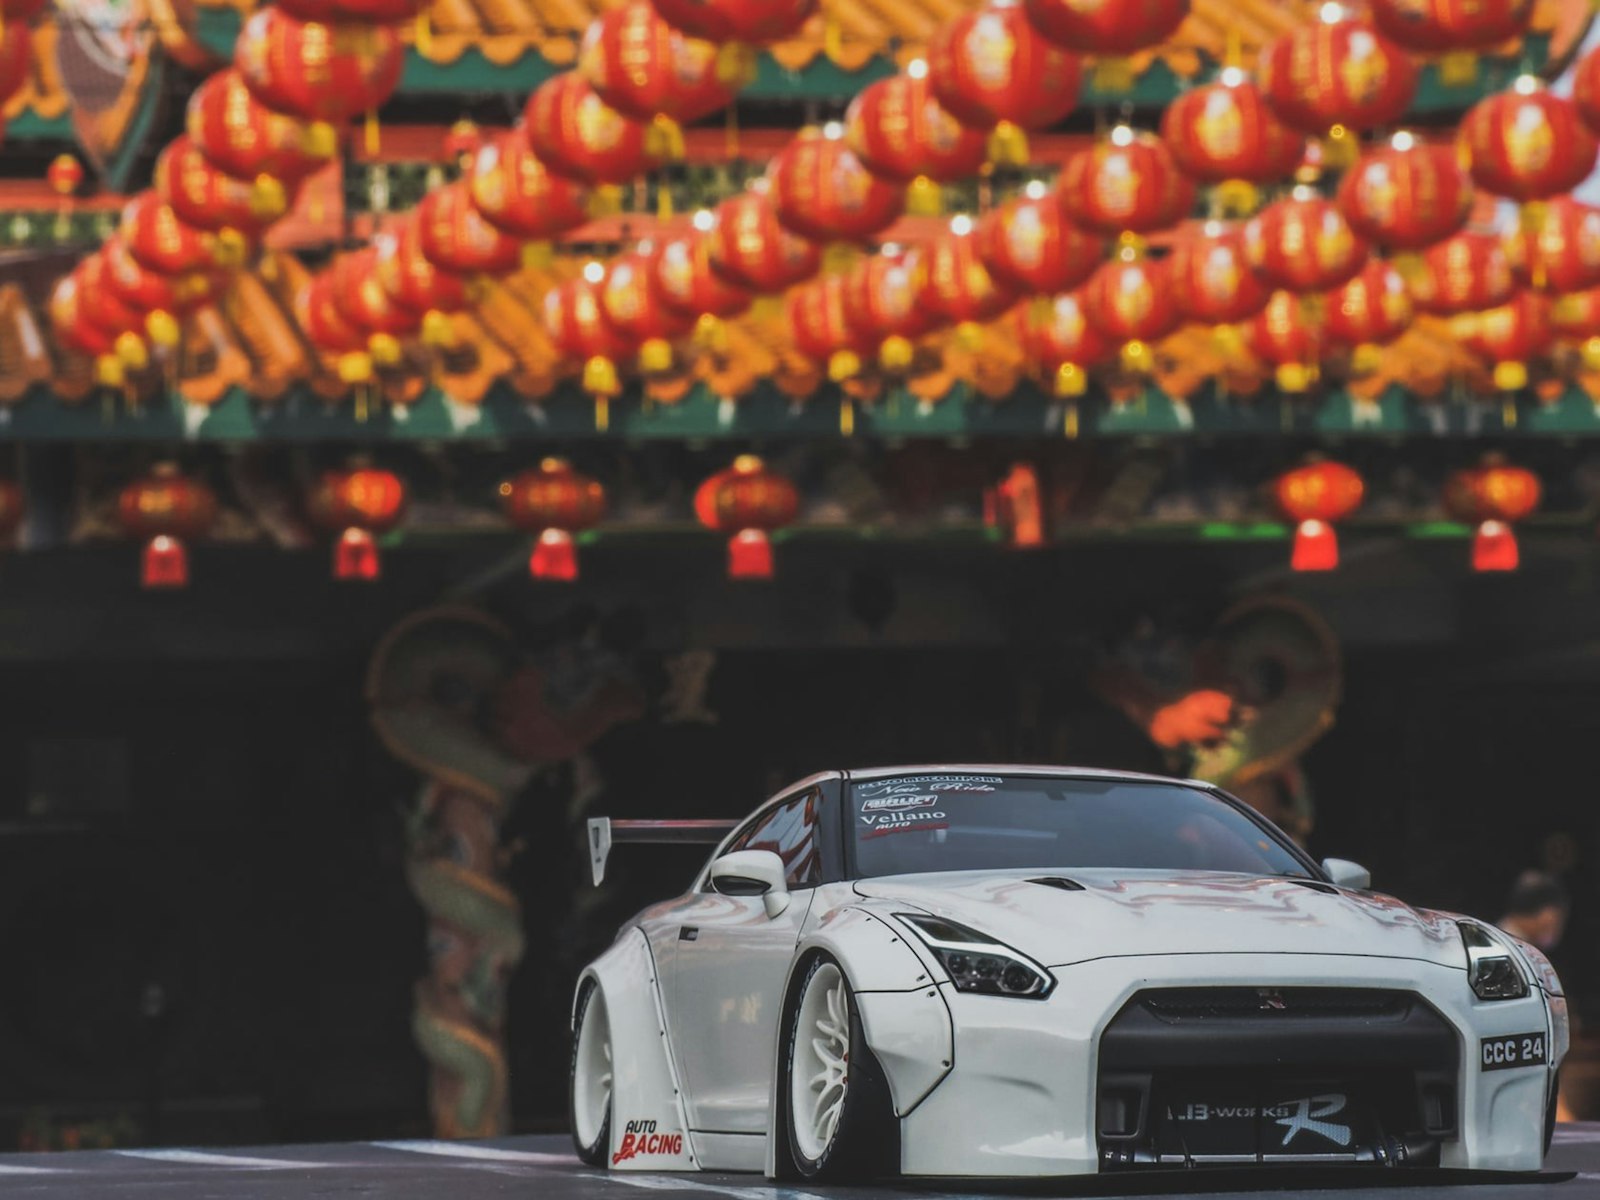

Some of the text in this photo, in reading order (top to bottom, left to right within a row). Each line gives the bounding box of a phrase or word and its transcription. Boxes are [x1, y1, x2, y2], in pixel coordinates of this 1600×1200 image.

[860, 811, 946, 825] Vellano
[875, 821, 911, 830] AUTO
[1483, 1037, 1543, 1064] CCC 24
[625, 1119, 657, 1134] AUTO
[1275, 1093, 1352, 1146] R
[616, 1133, 682, 1158] RACING
